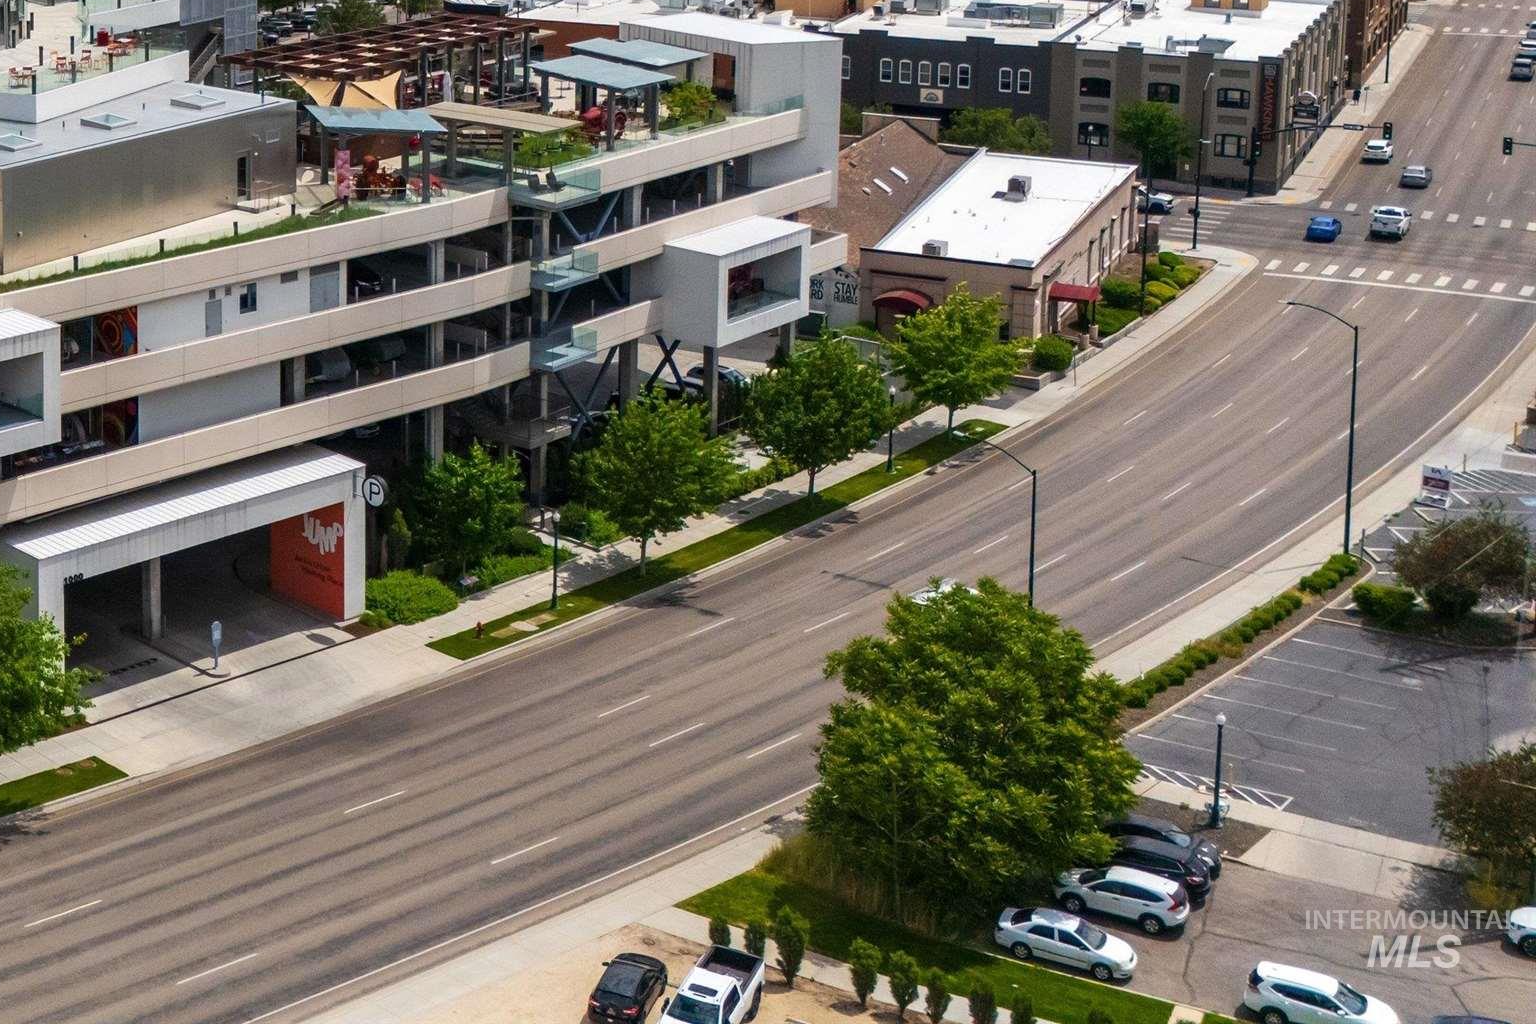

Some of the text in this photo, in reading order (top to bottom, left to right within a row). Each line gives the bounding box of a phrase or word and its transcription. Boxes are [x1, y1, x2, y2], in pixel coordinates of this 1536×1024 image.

[834, 281, 858, 297] STAY
[833, 294, 858, 305] HUMBLE
[302, 513, 344, 556] JUMP
